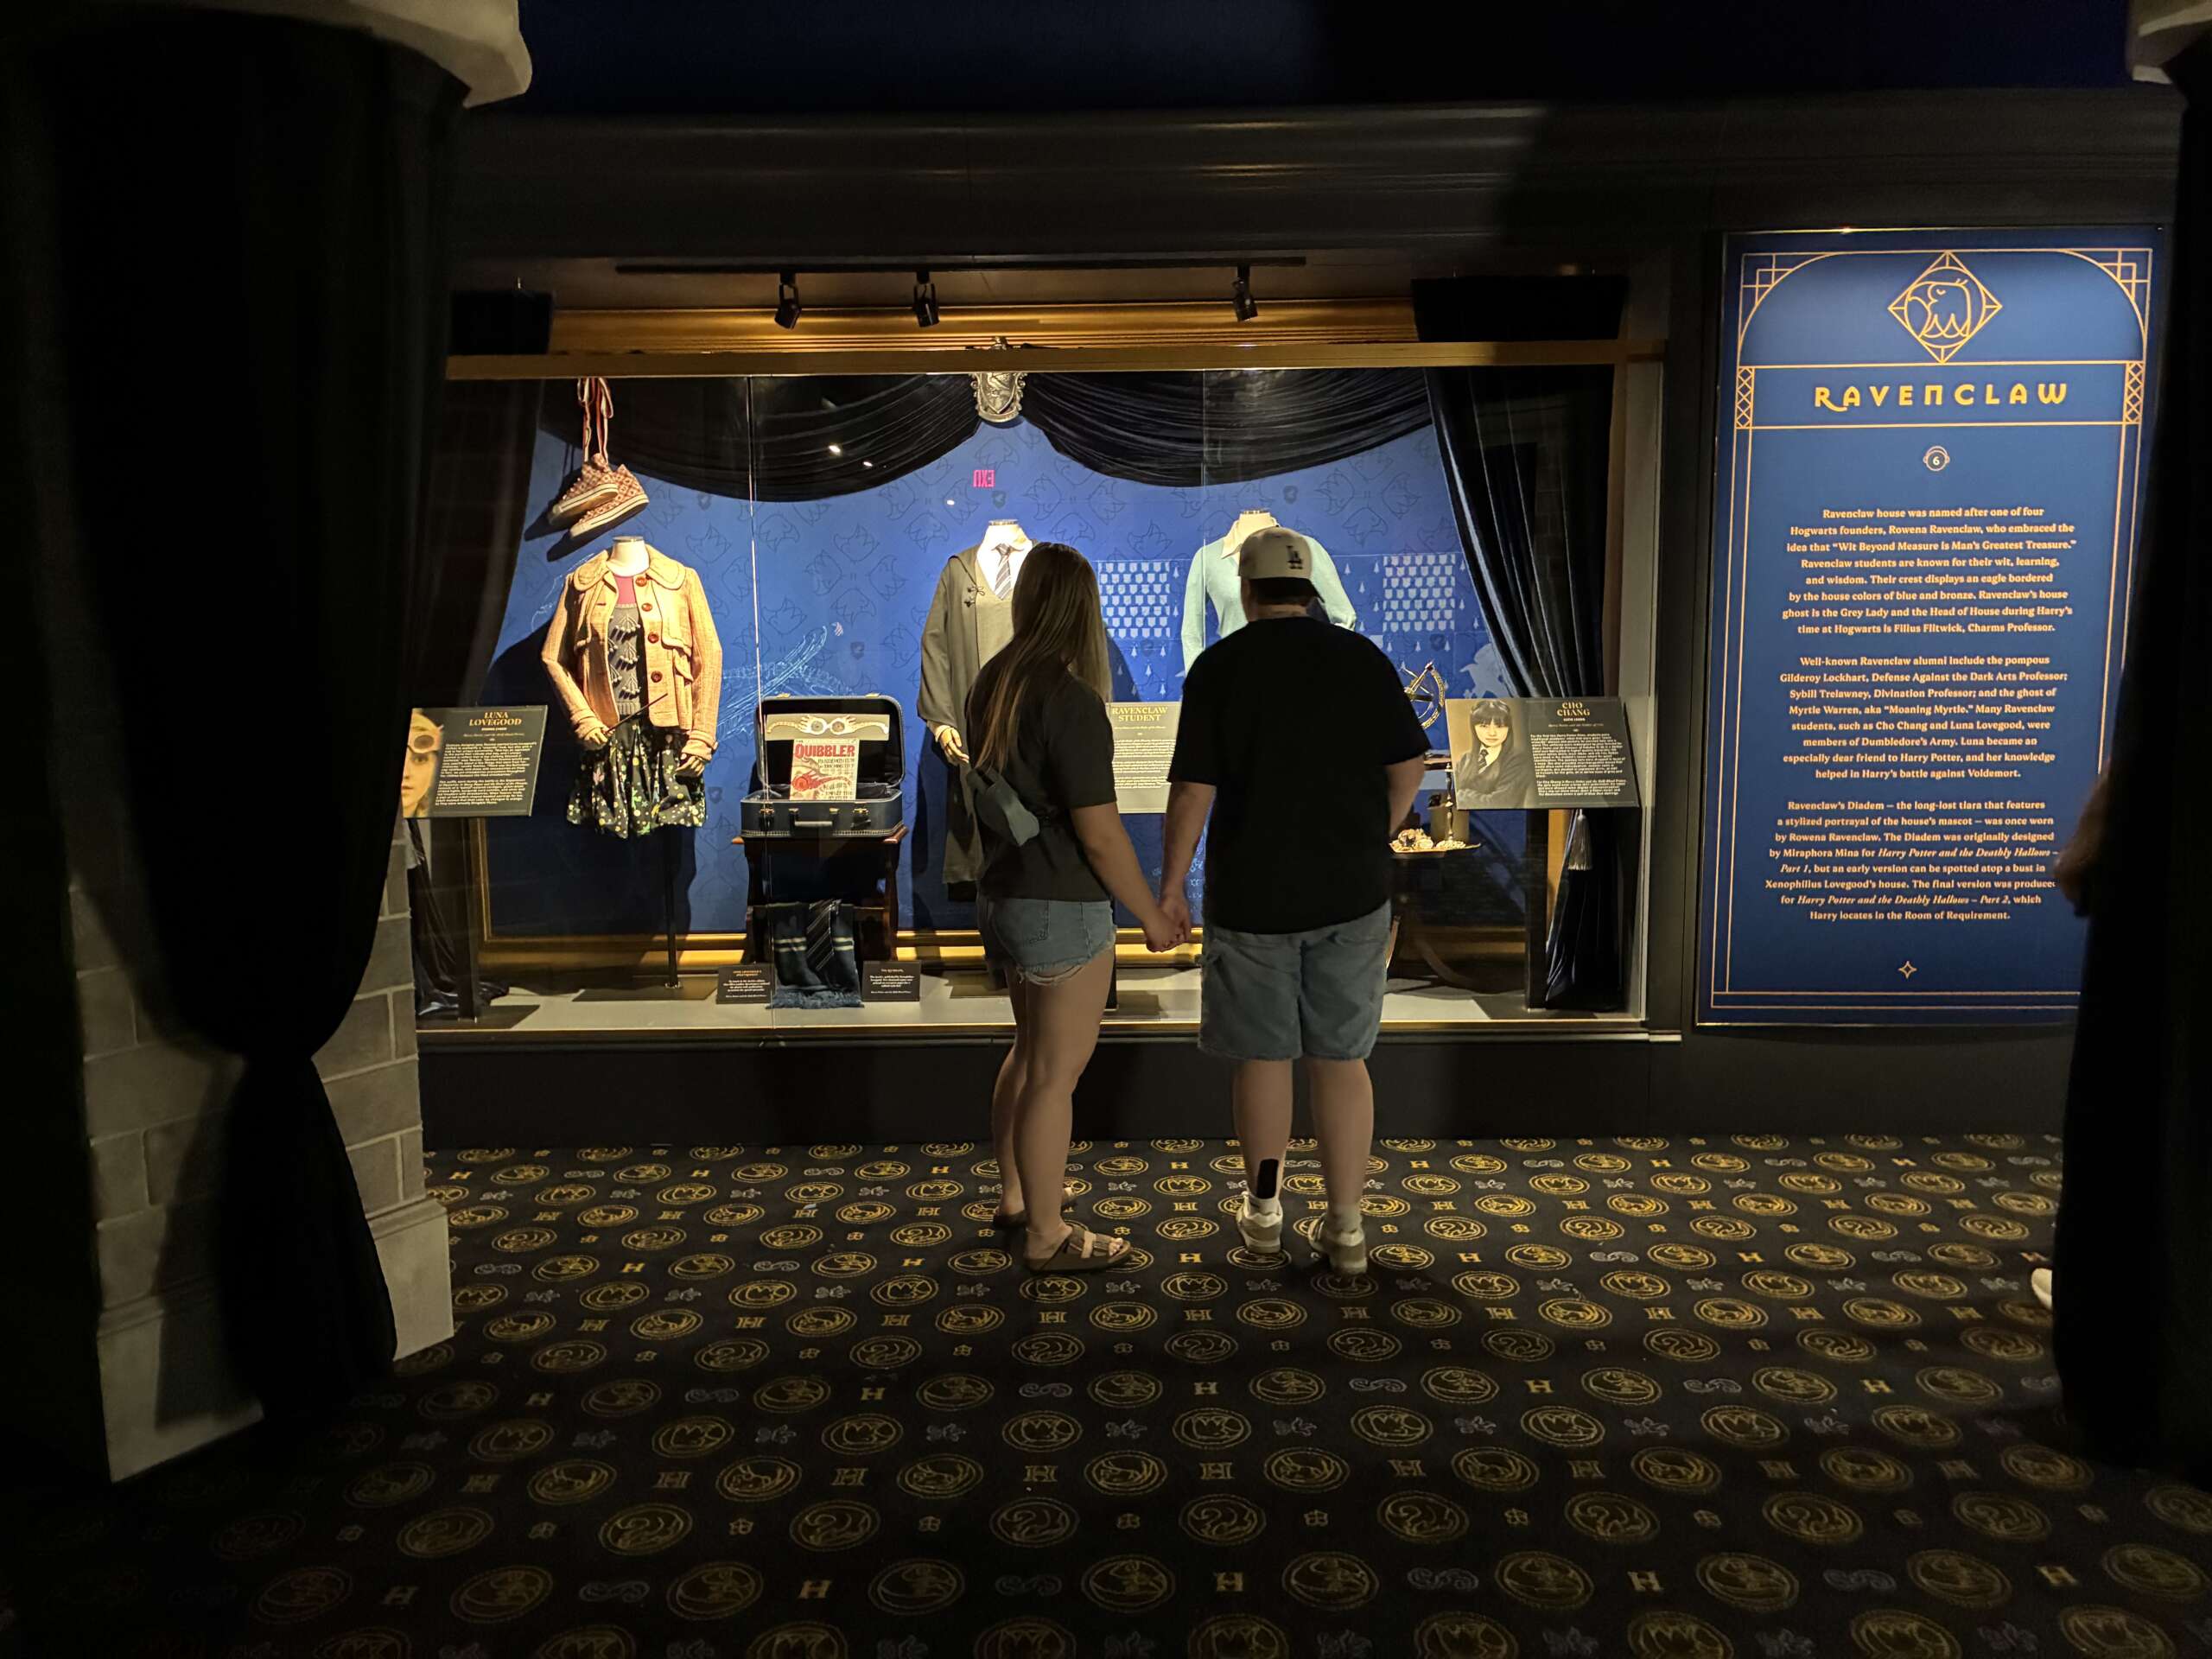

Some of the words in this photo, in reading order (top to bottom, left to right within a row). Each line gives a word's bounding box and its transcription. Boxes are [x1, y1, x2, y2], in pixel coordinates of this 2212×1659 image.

[1815, 383, 2067, 412] RAVENCLAW
[1823, 509, 1874, 518] Ravenclaw
[1876, 508, 1905, 518] house
[1928, 508, 1963, 517] named
[1963, 508, 1988, 517] after
[2009, 507, 2022, 517] of
[2022, 507, 2044, 516] four
[1790, 526, 1838, 537] Hogwarts
[1838, 525, 1885, 536] founders,
[1888, 525, 1928, 534] Rowena
[1928, 524, 1983, 535] Ravenclaw,
[1986, 524, 2007, 533] who
[2007, 524, 2057, 533] embraced
[2057, 524, 2074, 532] the
[1787, 543, 1808, 551] idea
[1808, 543, 1829, 551] that
[1857, 542, 1896, 553] Beyond
[1896, 542, 1939, 550] Measure
[1940, 542, 1950, 550] is
[1950, 541, 1980, 550] Man’s
[1980, 541, 2023, 550] Greatest
[1801, 558, 1853, 568] Ravenclaw
[1854, 558, 1897, 567] students
[1916, 558, 1949, 567] known
[1951, 557, 1967, 567] for
[1967, 557, 1993, 567] their
[1993, 558, 2013, 568] wit,
[2015, 557, 2059, 568] learning,
[1806, 575, 1825, 584] and
[1826, 575, 1867, 584] wisdom.
[1870, 575, 1897, 583] Their
[1923, 575, 1965, 585] displays
[1980, 574, 2007, 585] eagle
[2007, 574, 2053, 582] bordered
[1789, 592, 1801, 602] by
[1803, 592, 1819, 601] the
[1821, 591, 1850, 601] house
[1852, 591, 1881, 600] colors
[1883, 591, 1895, 600] of
[1895, 591, 1918, 600] blue
[1918, 591, 1938, 600] and
[1938, 590, 1976, 600] bronze.
[1977, 590, 2037, 599] Ravenclaw’s
[2037, 590, 2068, 599] house
[1797, 625, 1820, 633] time
[1821, 625, 1831, 633] at
[1834, 624, 1881, 635] Hogwarts
[1893, 624, 1922, 632] Filius
[1922, 623, 1965, 633] Flitwick,
[1967, 623, 2005, 632] Charms
[2005, 623, 2055, 632] Professor.
[1800, 657, 1859, 665] Well-known
[1859, 657, 1911, 665] Ravenclaw
[1912, 656, 1947, 665] alumni
[1948, 656, 1985, 664] include
[1986, 656, 2004, 664] the
[2004, 657, 2050, 666] pompous
[1780, 673, 1821, 683] Gilderoy
[1822, 673, 1868, 683] Lockhart,
[1872, 672, 1910, 682] Defense
[1911, 672, 1949, 683] Against
[1951, 672, 1968, 681] the
[1968, 672, 1993, 681] Dark
[1995, 672, 2018, 681] Arts
[2018, 671, 2067, 682] Professor;
[1789, 705, 1821, 716] Myrtle
[1823, 705, 1861, 715] Warren,
[1864, 705, 1881, 714] aka
[1975, 704, 2001, 715] Many
[2004, 704, 2054, 713] Ravenclaw
[469, 718, 522, 727] LOVEGOOD
[1802, 737, 1847, 746] members
[1847, 737, 1859, 746] of
[1860, 737, 1927, 746] Dumbledore’s
[1929, 737, 1958, 747] Army.
[1960, 737, 1985, 746] Luna
[1985, 736, 2024, 746] became
[795, 744, 855, 759] QUIBBLER
[1783, 753, 1830, 764] especially
[1832, 753, 1853, 762] dear
[1855, 753, 1885, 762] friend
[1887, 753, 1897, 762] to
[1900, 753, 1929, 764] Harry
[1930, 753, 1963, 763] Potter,
[1965, 753, 1985, 761] and
[1985, 753, 2001, 761] her
[2004, 753, 2055, 763] knowledge
[1815, 769, 1849, 780] helped
[1860, 769, 1898, 780] Harry’s
[1898, 769, 1928, 778] battle
[1929, 769, 1964, 779] against
[1967, 769, 2020, 778] Voldemort.
[1788, 801, 1845, 810] Ravenclaw’s
[1847, 801, 1884, 810] Diadem
[1896, 801, 1911, 810] the
[1914, 801, 1956, 811] long-lost
[1958, 801, 1981, 810] tiara
[1984, 801, 2005, 810] that
[2005, 801, 2045, 810] features
[1775, 833, 1786, 843] by
[1789, 832, 1826, 842] Rowena
[1827, 832, 1880, 842] Ravenclaw.
[1884, 832, 1902, 842] The
[1904, 832, 1941, 841] Diadem
[1962, 832, 2009, 842] originally
[2011, 832, 2054, 842] designed
[1810, 911, 1837, 922] Harry
[1839, 911, 1873, 919] locates
[1886, 911, 1902, 919] the
[1904, 911, 1932, 919] Room
[1934, 911, 1945, 919] of
[1945, 911, 2010, 921] Requirement.
